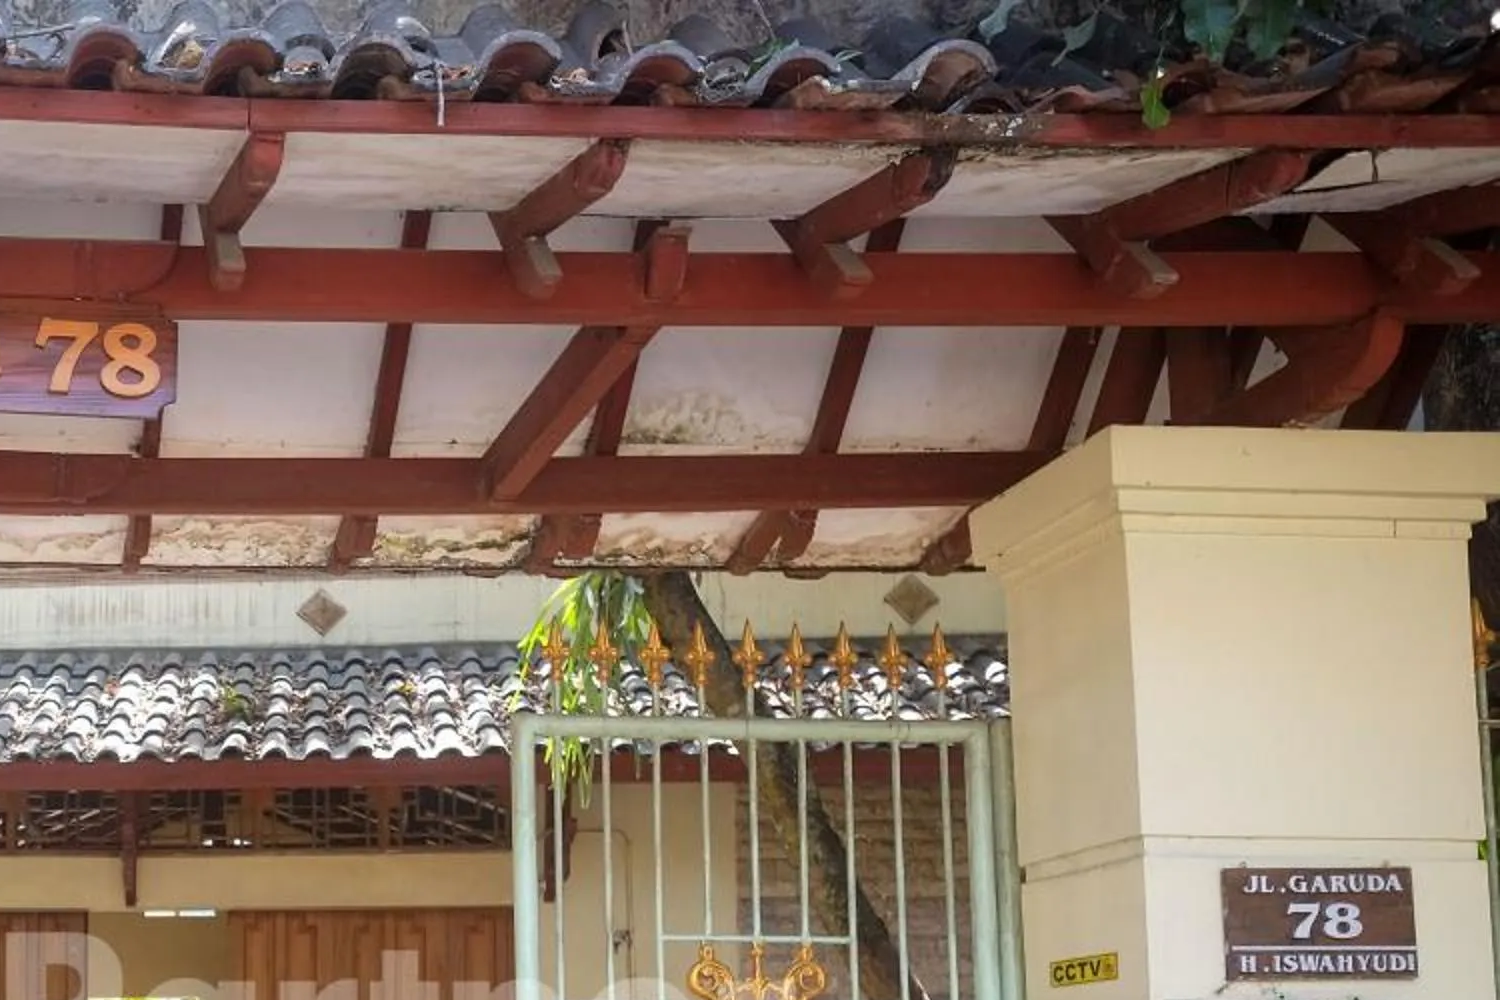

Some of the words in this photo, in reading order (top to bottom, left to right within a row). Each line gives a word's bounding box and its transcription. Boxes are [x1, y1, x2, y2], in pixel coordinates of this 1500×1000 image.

[35, 317, 162, 398] 78
[1289, 873, 1403, 893] GARUDA
[1287, 901, 1363, 940] 78
[1053, 959, 1101, 983] CCTV
